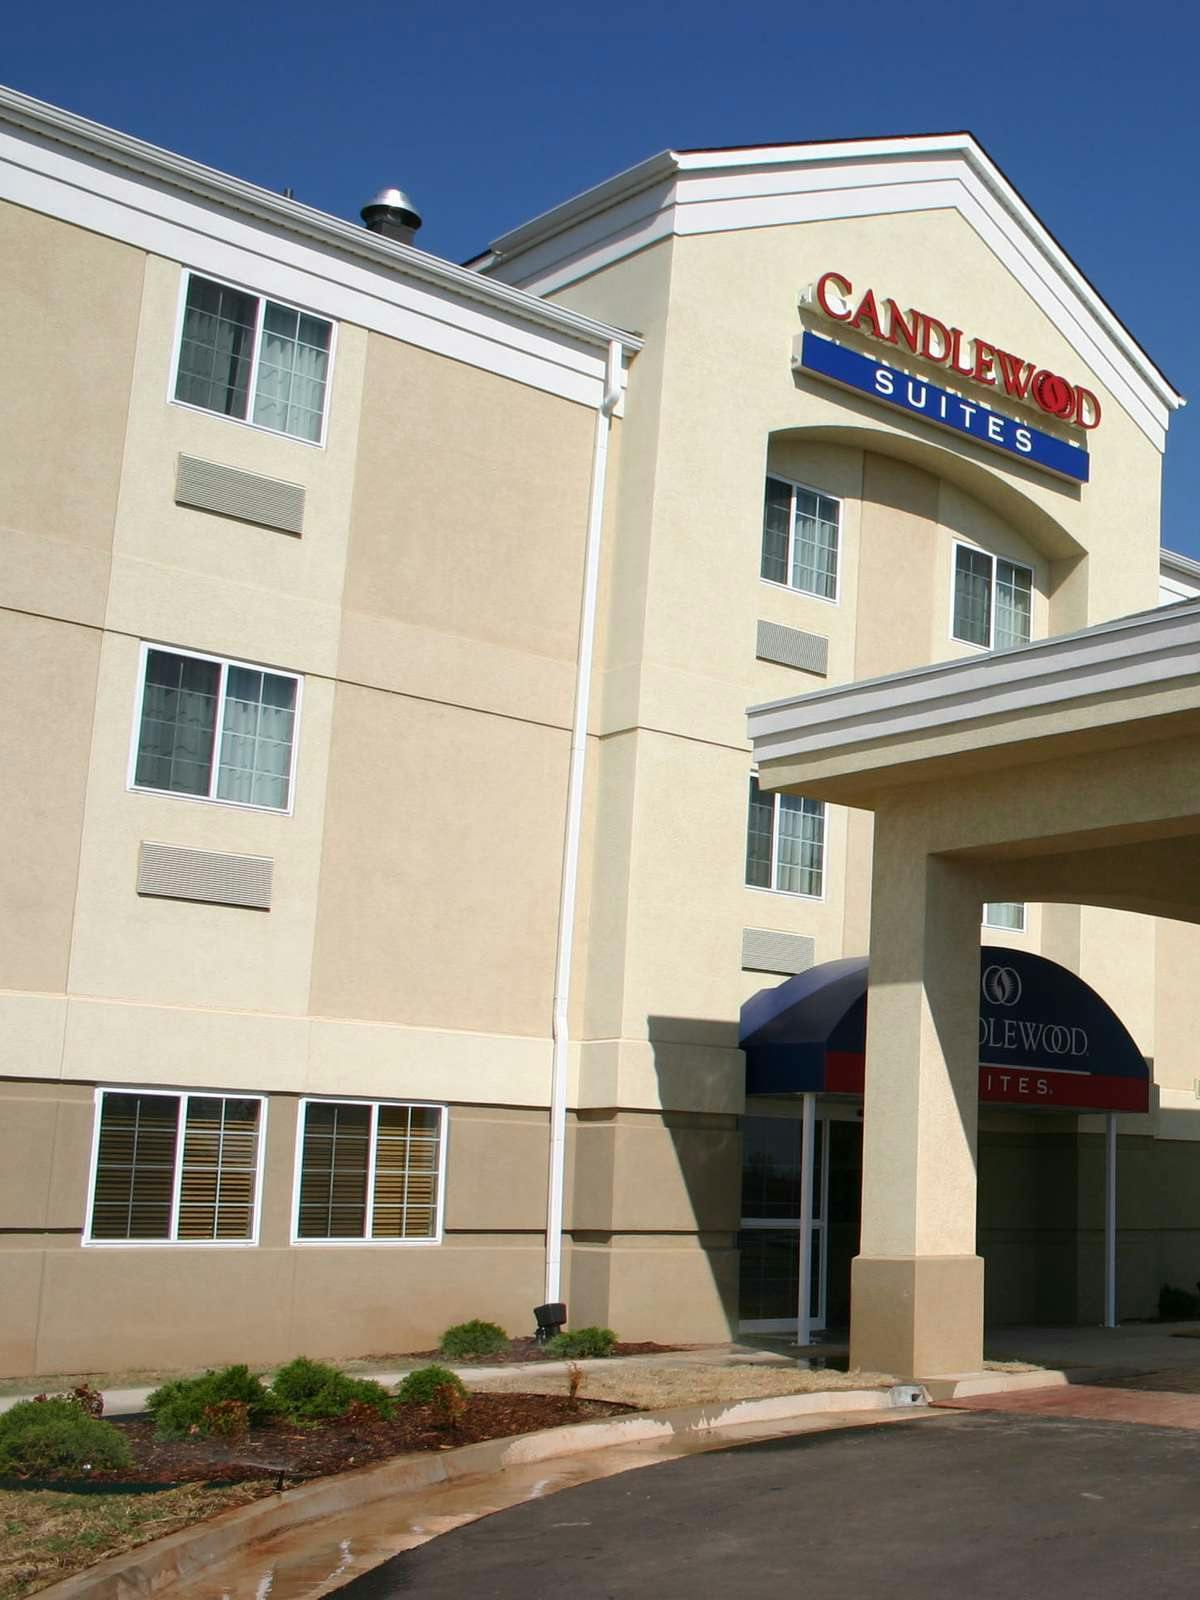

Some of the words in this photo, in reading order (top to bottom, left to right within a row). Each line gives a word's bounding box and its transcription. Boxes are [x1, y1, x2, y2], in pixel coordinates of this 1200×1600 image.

[816, 272, 1102, 430] CANDLEWOOD
[874, 369, 1033, 453] SUITES
[978, 1016, 1088, 1056] DLEWOOD
[987, 1074, 1049, 1095] ITES
